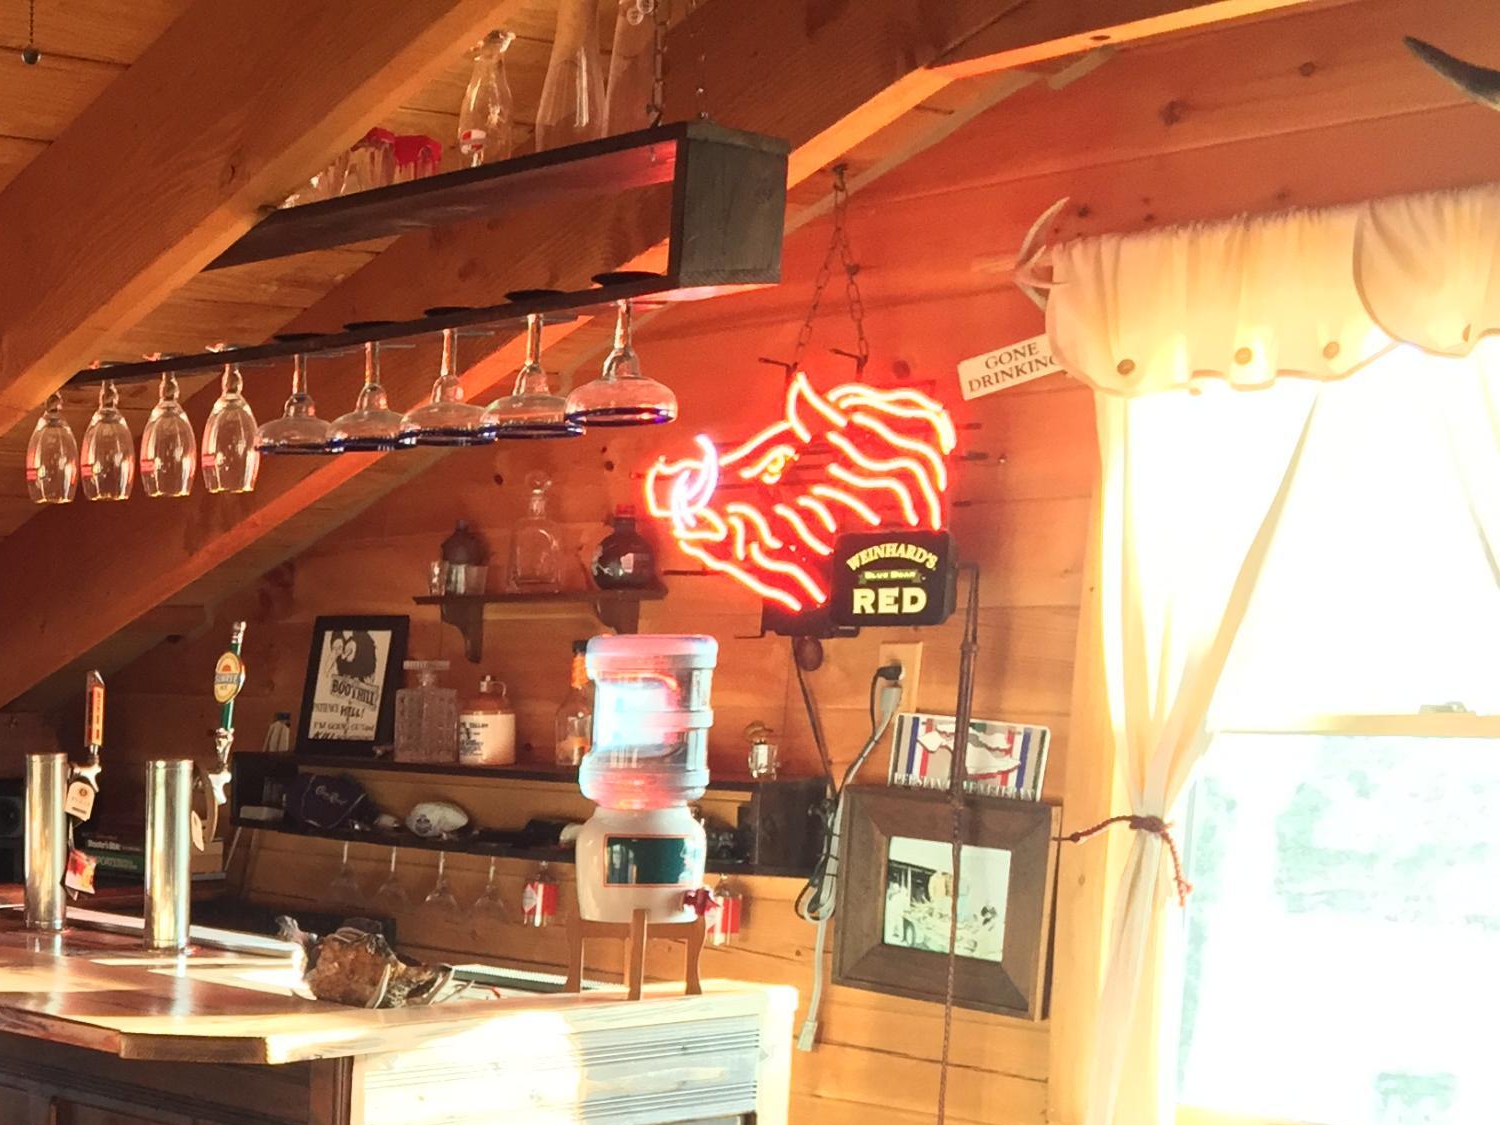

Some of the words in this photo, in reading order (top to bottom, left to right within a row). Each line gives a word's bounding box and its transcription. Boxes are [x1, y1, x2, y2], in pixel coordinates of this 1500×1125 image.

[985, 342, 1040, 370] GONE
[846, 542, 938, 570] WEINHARD'S
[852, 587, 927, 614] RED
